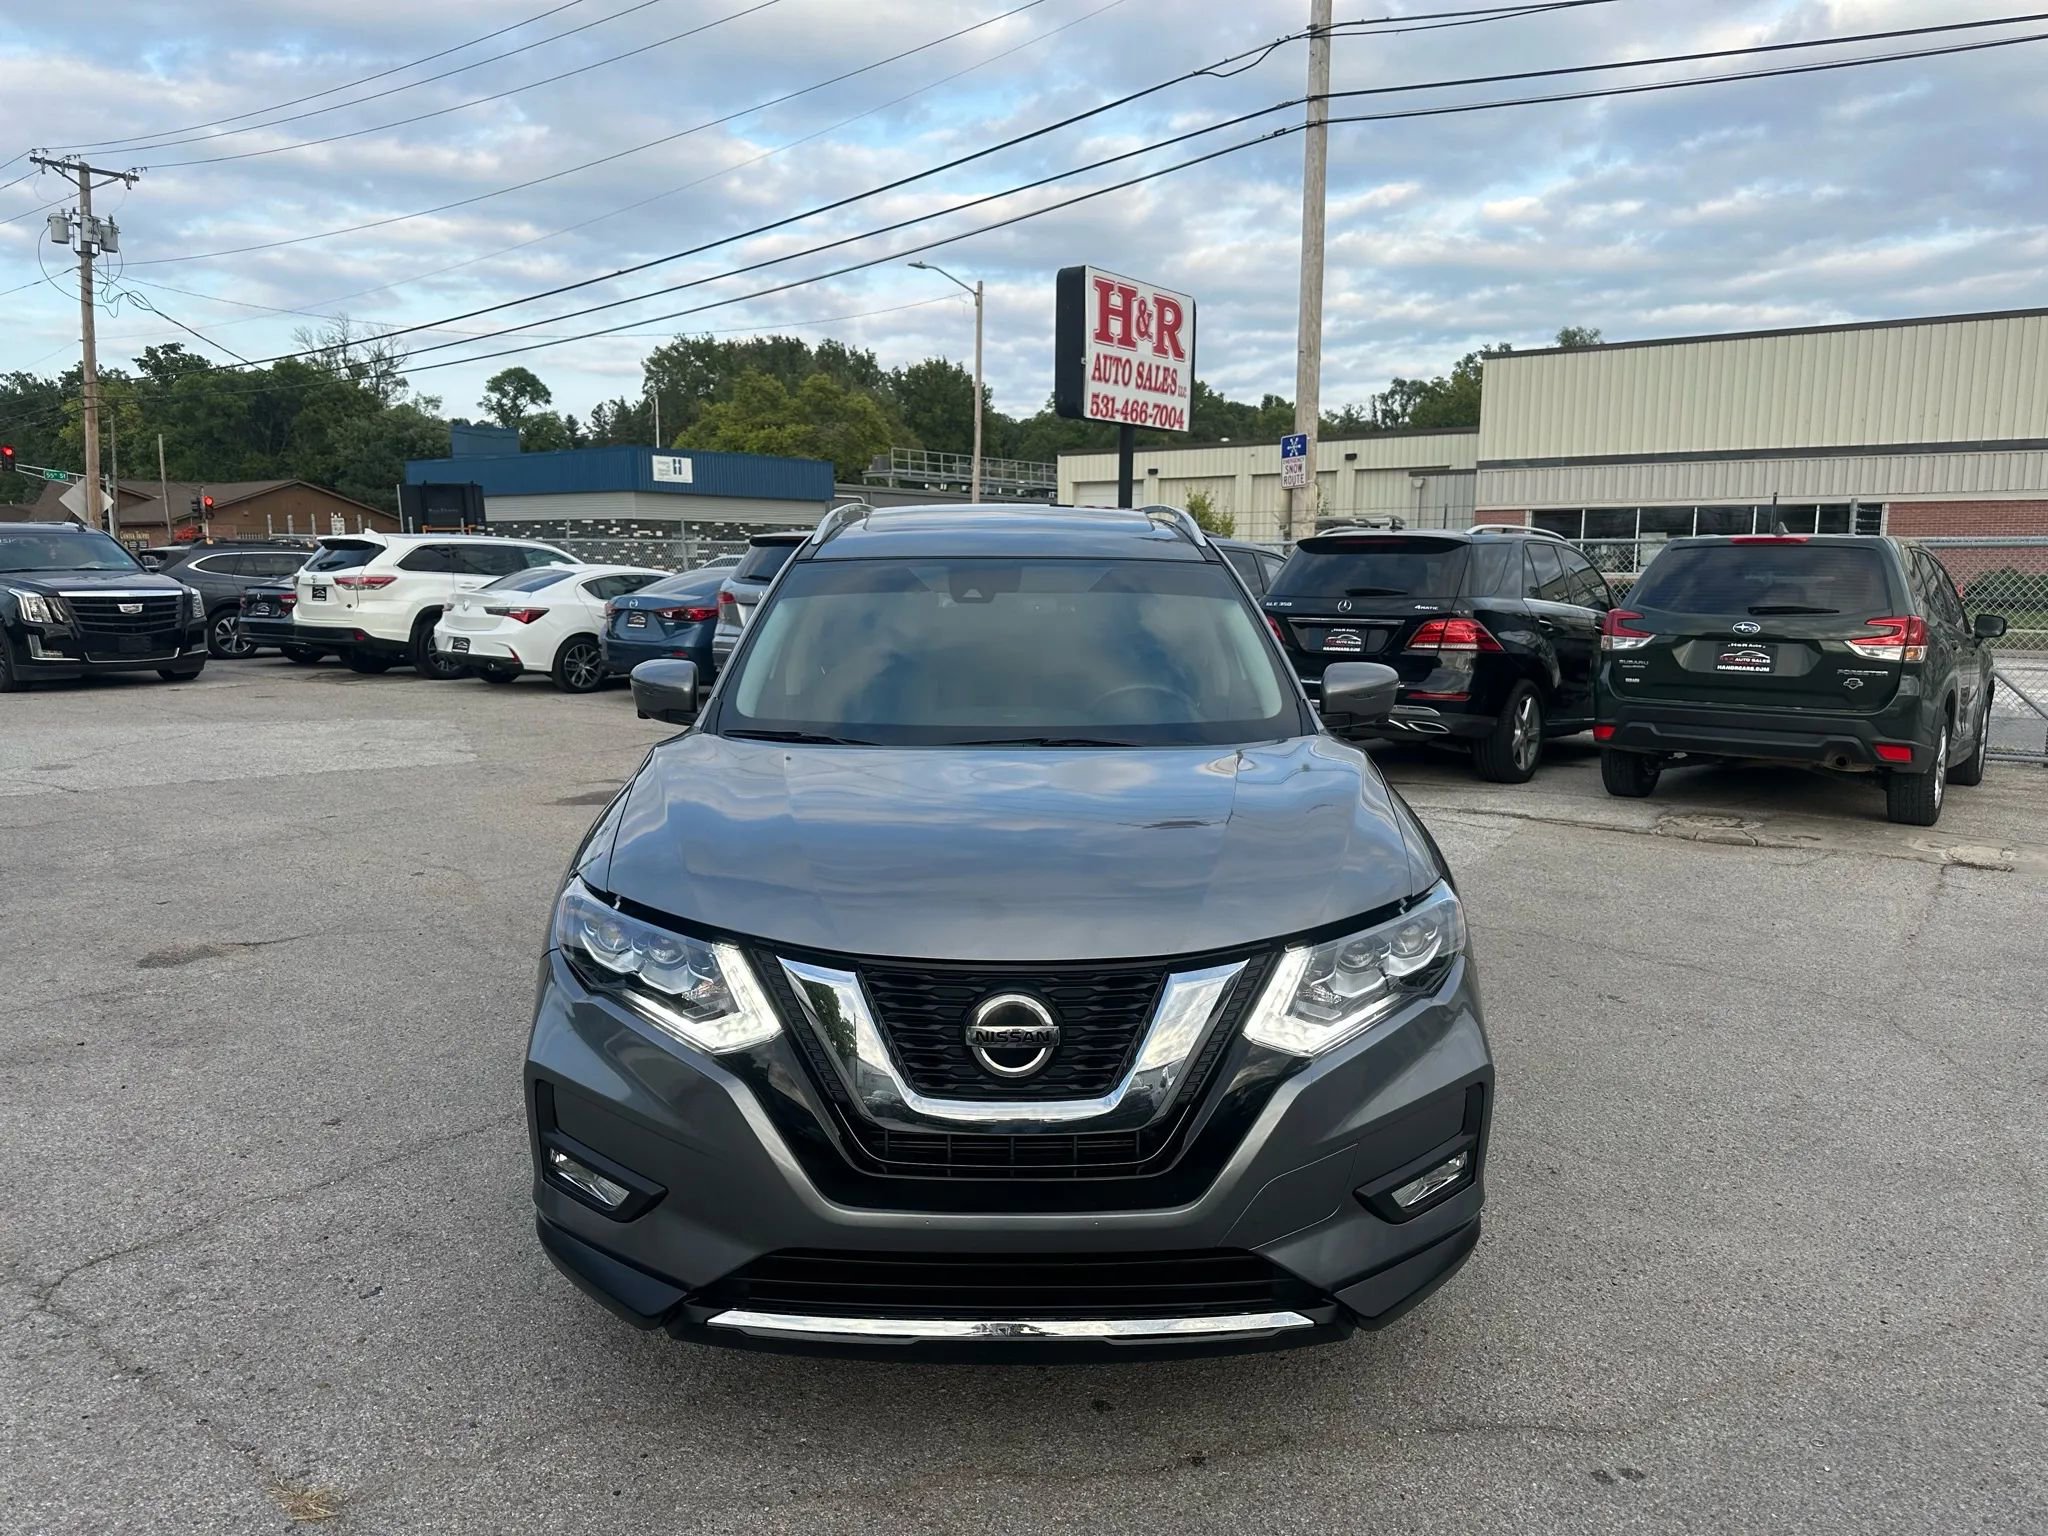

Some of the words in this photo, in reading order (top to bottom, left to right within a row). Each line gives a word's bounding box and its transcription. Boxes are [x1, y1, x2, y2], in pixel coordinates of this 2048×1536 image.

[1093, 276, 1185, 362] H&R
[1092, 353, 1132, 388] AUTO
[1135, 361, 1178, 397] SALES
[1090, 392, 1184, 430] 531-466-7004
[1283, 473, 1305, 486] ROUTE
[1284, 463, 1303, 475] SNOW
[975, 1031, 1050, 1043] NISSAN
